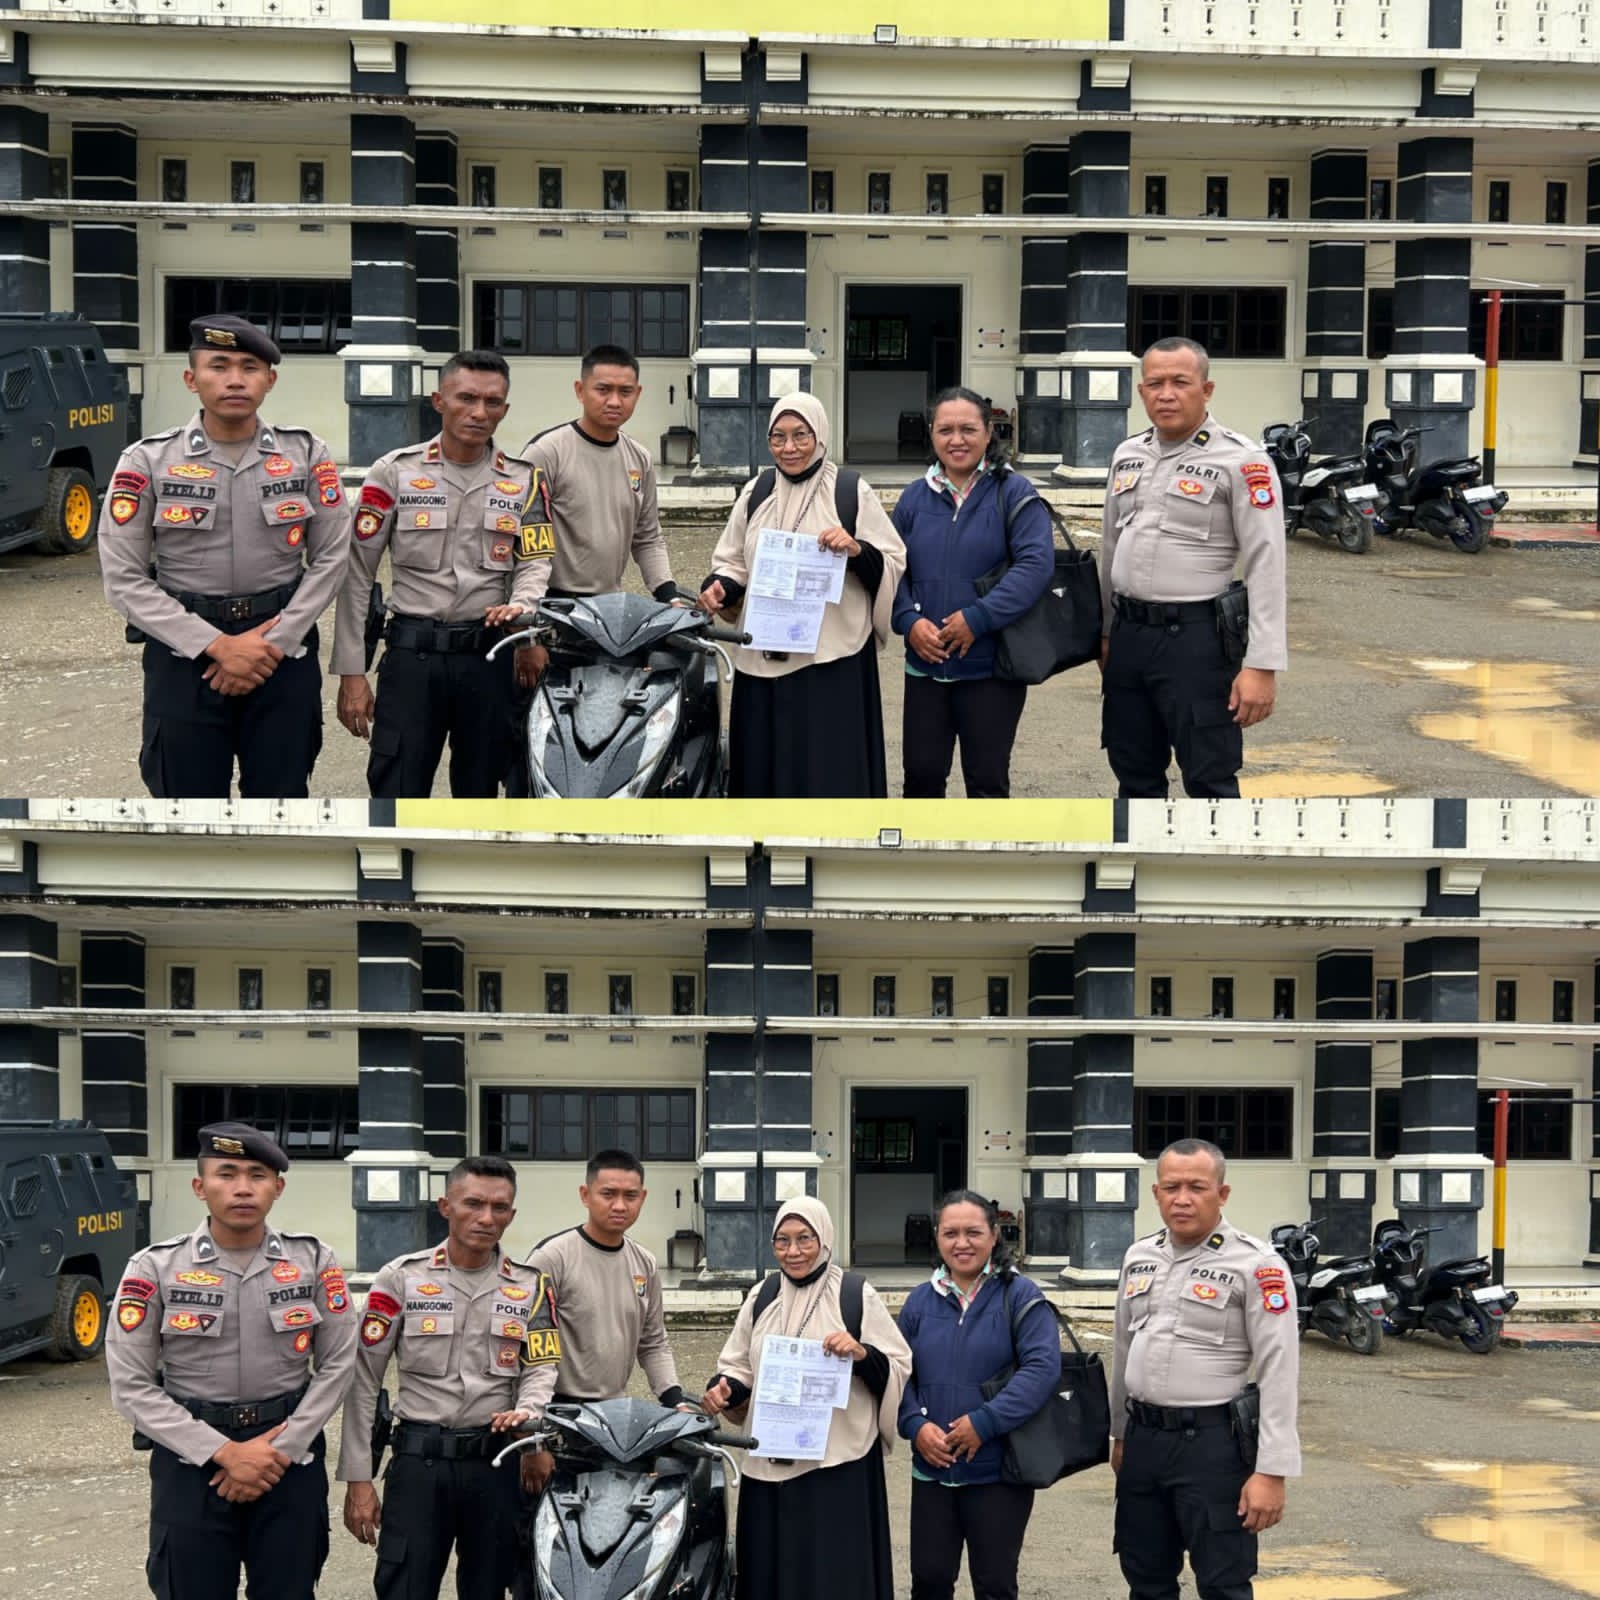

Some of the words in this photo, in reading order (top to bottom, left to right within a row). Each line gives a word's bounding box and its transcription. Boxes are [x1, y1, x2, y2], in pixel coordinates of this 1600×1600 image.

[69, 403, 114, 429] POLISI
[1176, 463, 1220, 481] POLRI
[262, 480, 305, 498] POLRI
[78, 1210, 123, 1236] POLISI
[1190, 1267, 1235, 1285] POLRI
[269, 1286, 312, 1304] POLRI
